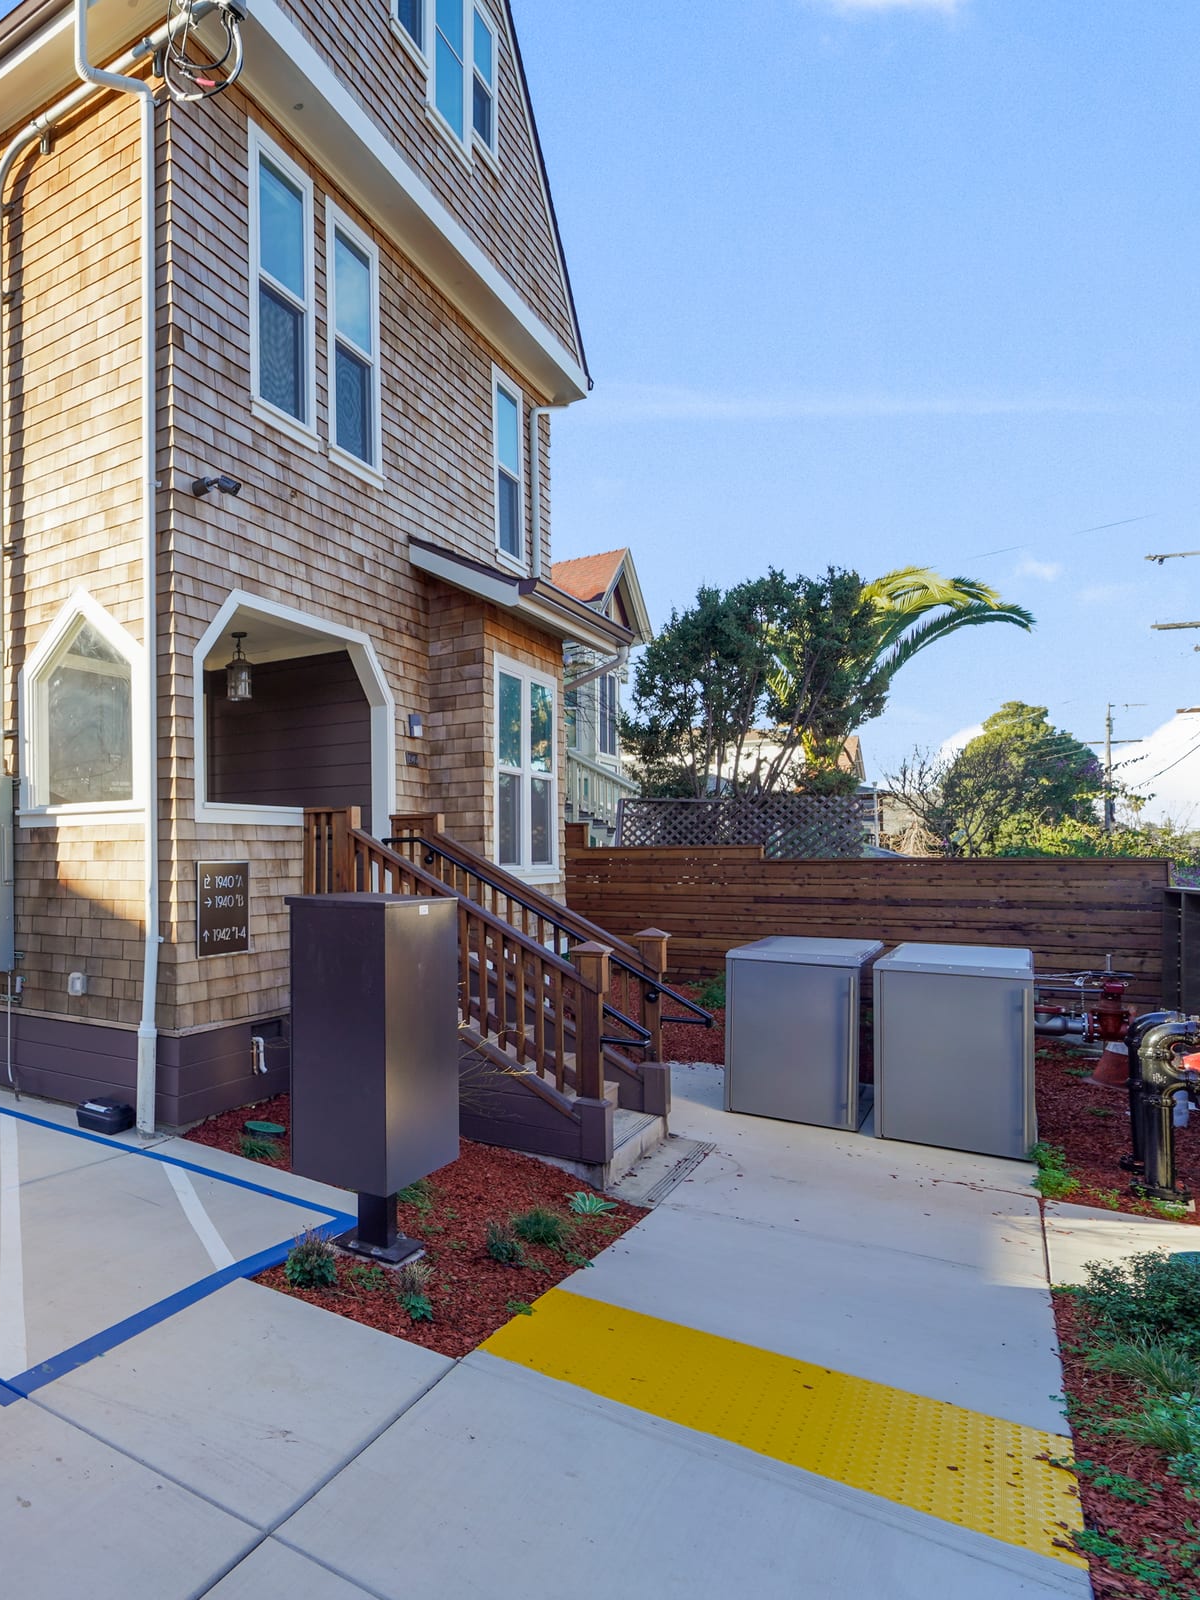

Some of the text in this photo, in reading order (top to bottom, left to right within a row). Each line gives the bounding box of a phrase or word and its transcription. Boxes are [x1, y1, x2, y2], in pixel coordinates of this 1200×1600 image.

[214, 875, 235, 889] 1940
[214, 895, 235, 908] 1940
[212, 927, 231, 942] 1942
